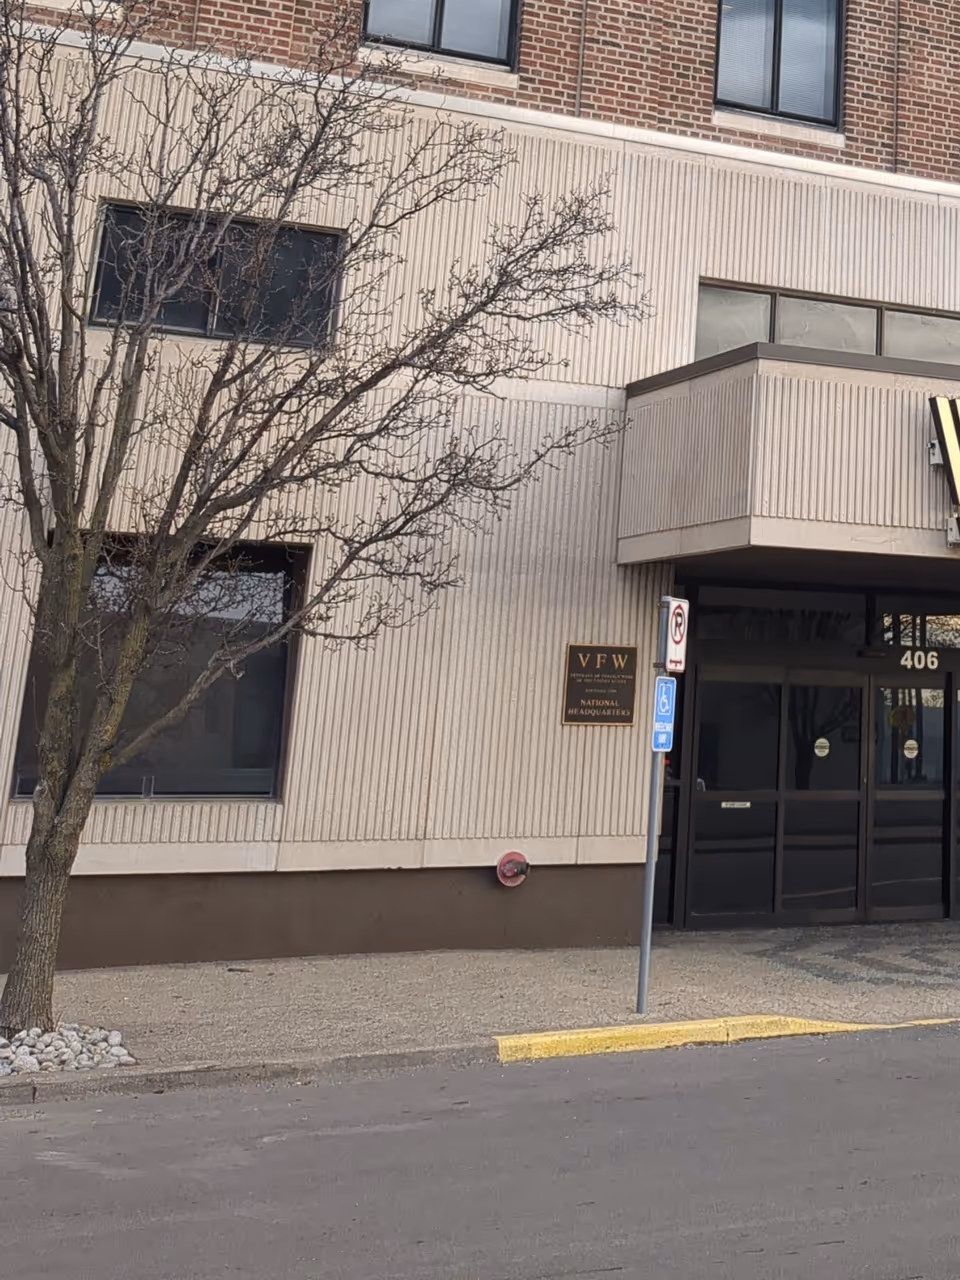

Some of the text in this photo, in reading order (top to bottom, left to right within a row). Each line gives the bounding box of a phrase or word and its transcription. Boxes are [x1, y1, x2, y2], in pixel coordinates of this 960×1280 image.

[900, 650, 939, 670] 406
[580, 699, 620, 707] NATIONAL
[568, 707, 631, 717] HEADQUARTERS
